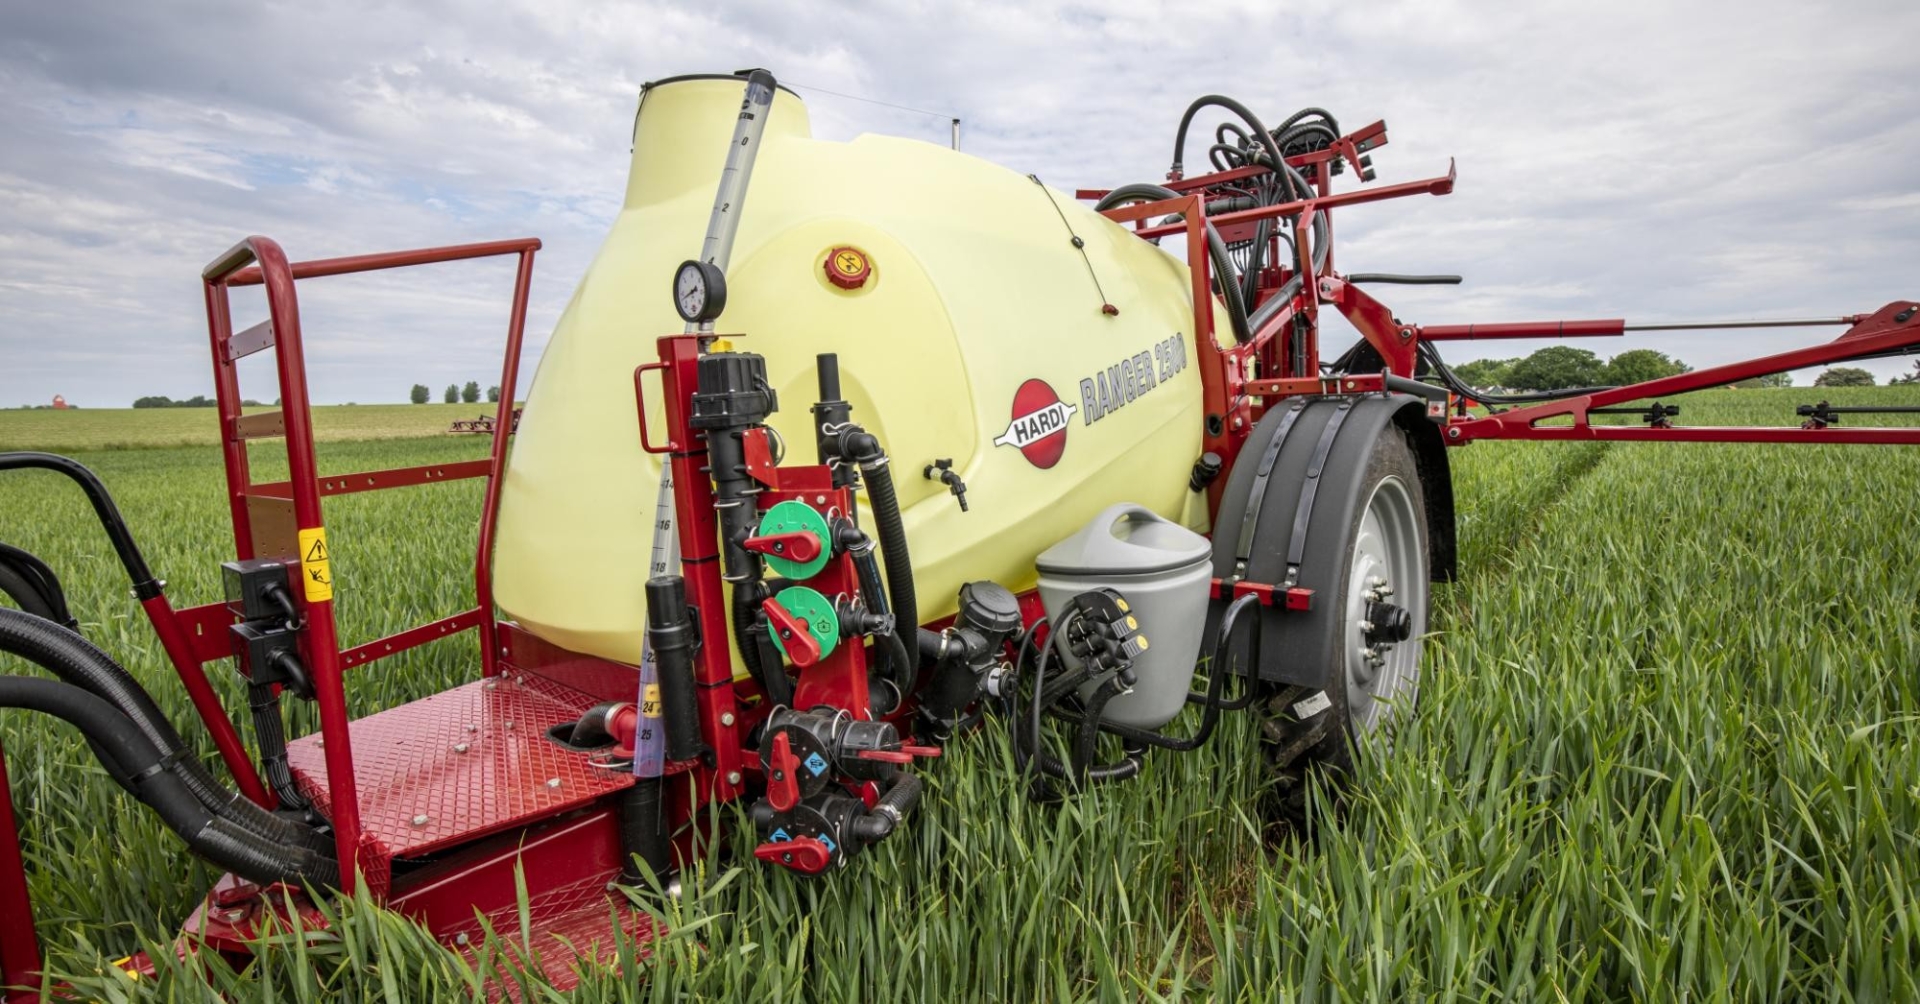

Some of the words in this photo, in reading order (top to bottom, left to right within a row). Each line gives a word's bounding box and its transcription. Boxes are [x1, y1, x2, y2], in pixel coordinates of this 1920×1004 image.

[741, 136, 749, 146] 0
[721, 202, 730, 213] 2
[1079, 349, 1157, 427] RANGER
[1013, 405, 1066, 443] HARDI
[660, 520, 671, 531] 16
[655, 562, 666, 573] 18
[642, 702, 654, 713] 24
[641, 729, 652, 740] 25
